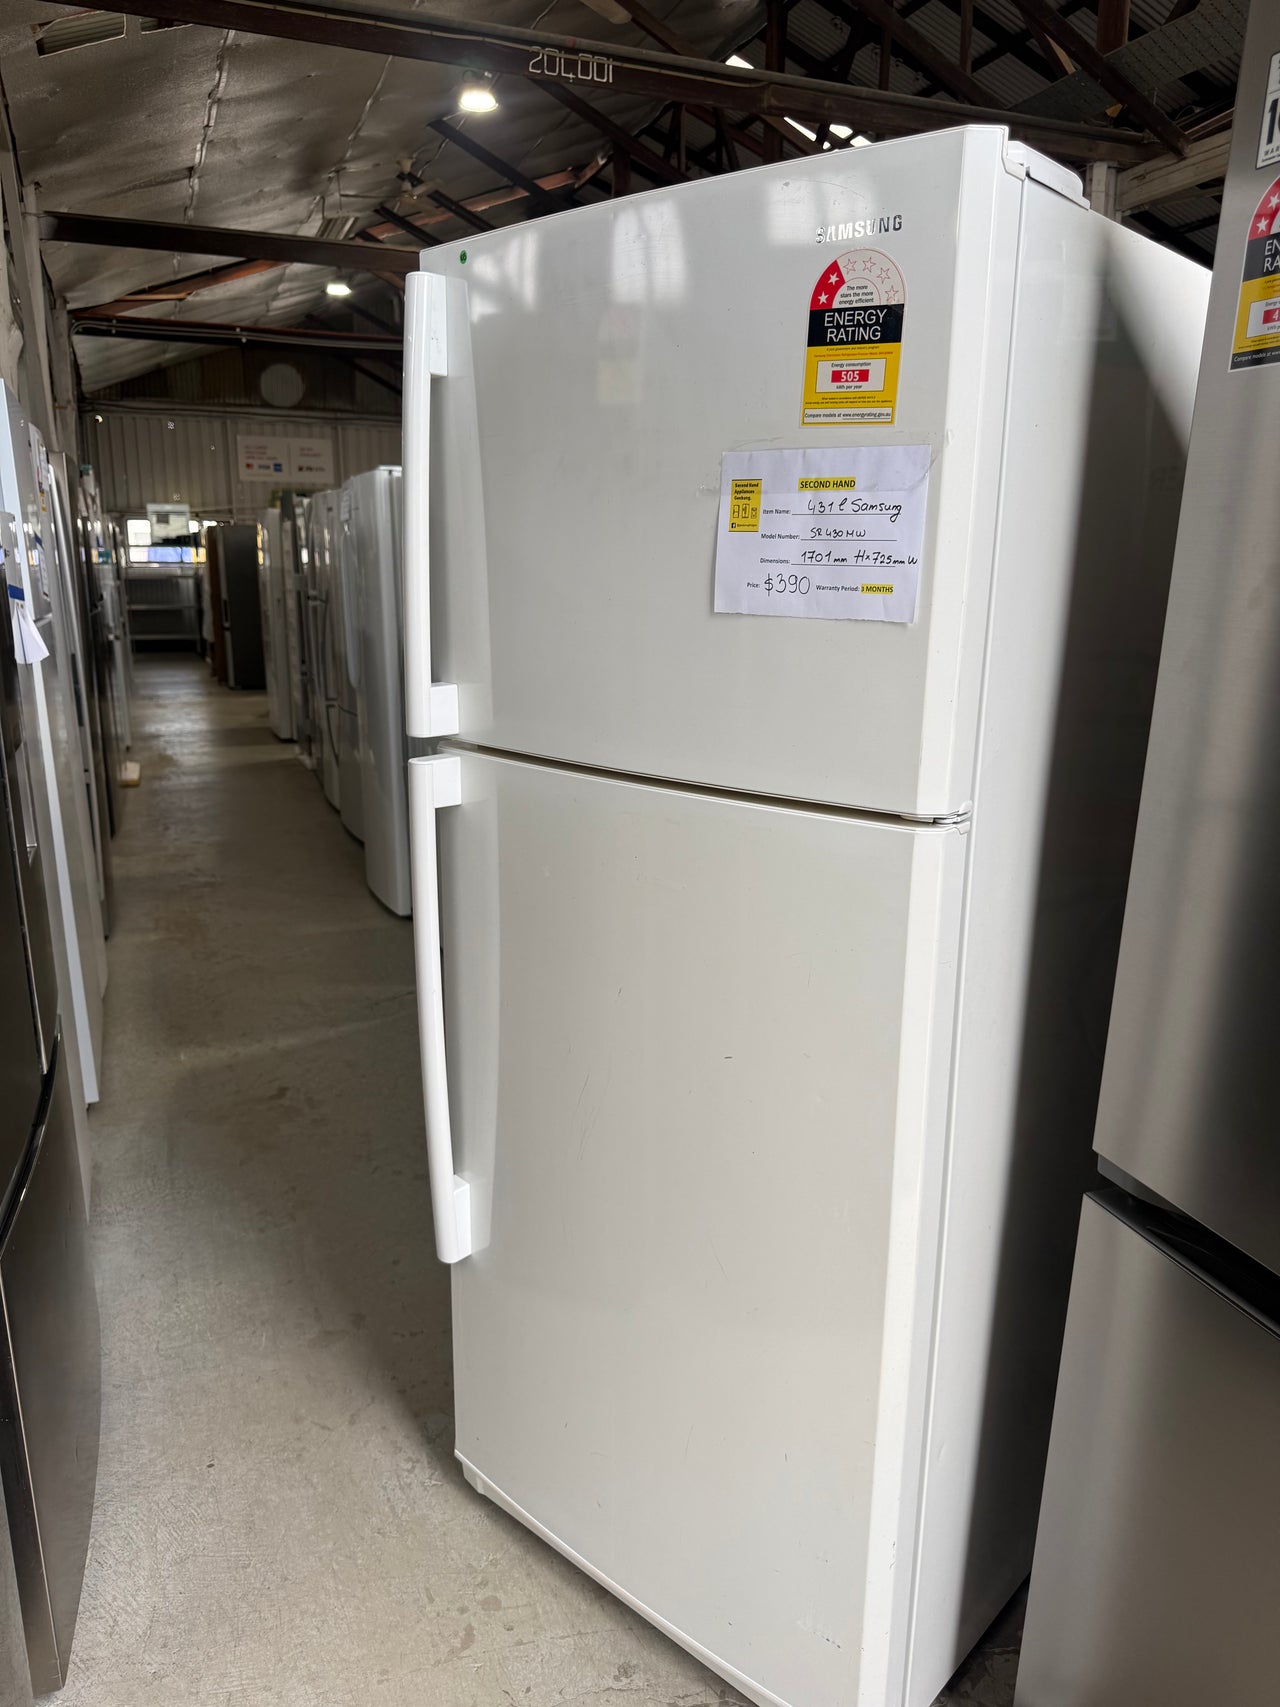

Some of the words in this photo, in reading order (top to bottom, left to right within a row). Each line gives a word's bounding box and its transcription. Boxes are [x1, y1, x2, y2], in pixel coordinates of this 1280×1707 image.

[1268, 98, 1280, 145] 1
[816, 214, 903, 244] SAMSUNG
[824, 308, 888, 327] ENERGY
[827, 326, 881, 343] RATING
[840, 370, 860, 382] 505
[800, 480, 830, 488] SECOND
[832, 479, 856, 488] HAND
[807, 499, 834, 514] 431
[852, 498, 903, 523] Samsung
[764, 573, 811, 597] $390
